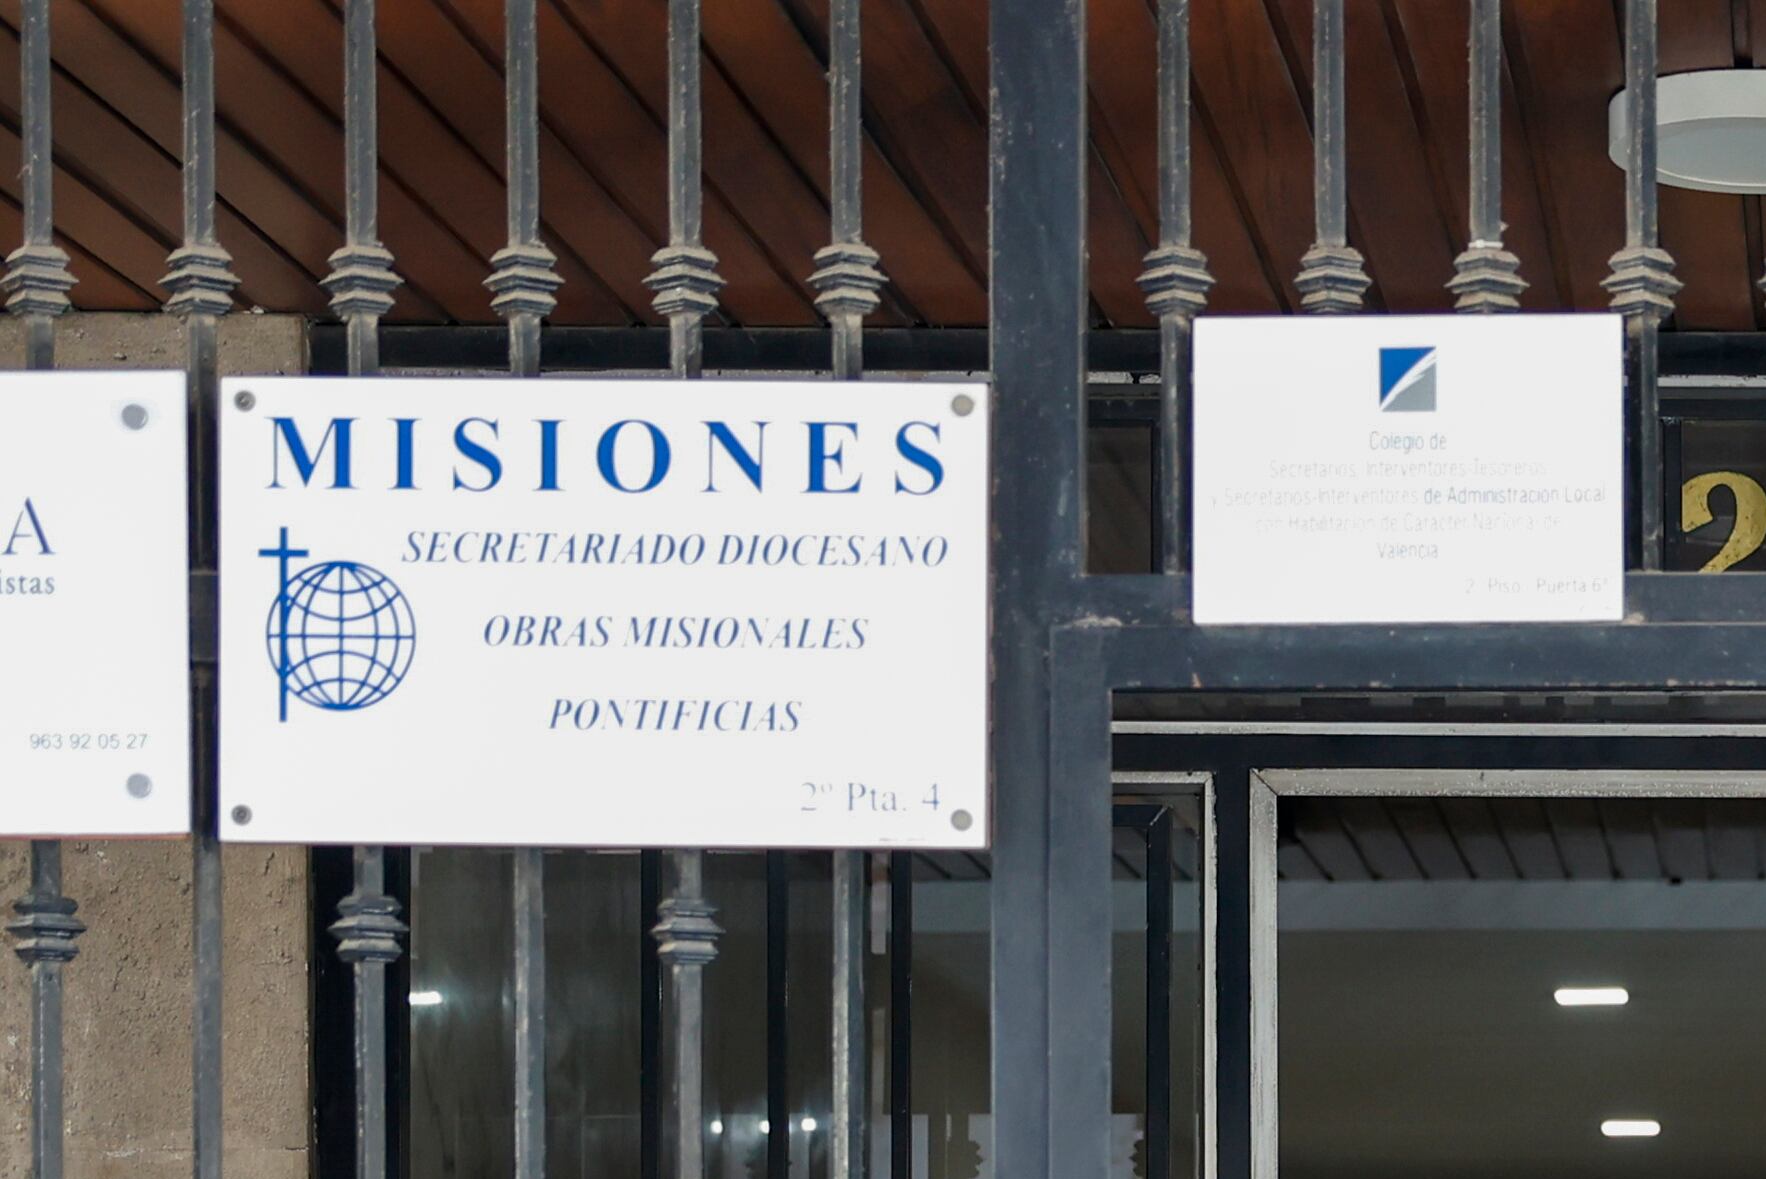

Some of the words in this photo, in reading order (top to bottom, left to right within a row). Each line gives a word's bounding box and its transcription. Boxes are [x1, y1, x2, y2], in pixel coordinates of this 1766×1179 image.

[266, 415, 946, 497] MISIONES
[1369, 431, 1424, 455] Colegio
[1429, 432, 1447, 450] de
[1424, 487, 1442, 505] de
[1564, 485, 1606, 504] Local
[1, 496, 57, 557] A
[401, 530, 707, 566] SECRETARIADO
[717, 533, 950, 568] DIOCESANO
[1376, 541, 1439, 561] Valencia
[483, 615, 613, 649] OBRAS
[623, 615, 870, 650] MISIONALES
[548, 698, 803, 733] PONTIFICIAS
[29, 733, 63, 750] 963
[69, 733, 92, 750] 92
[97, 733, 121, 750] 05
[126, 733, 148, 750] 27
[847, 781, 907, 812] Pta.
[921, 782, 941, 812] 4
